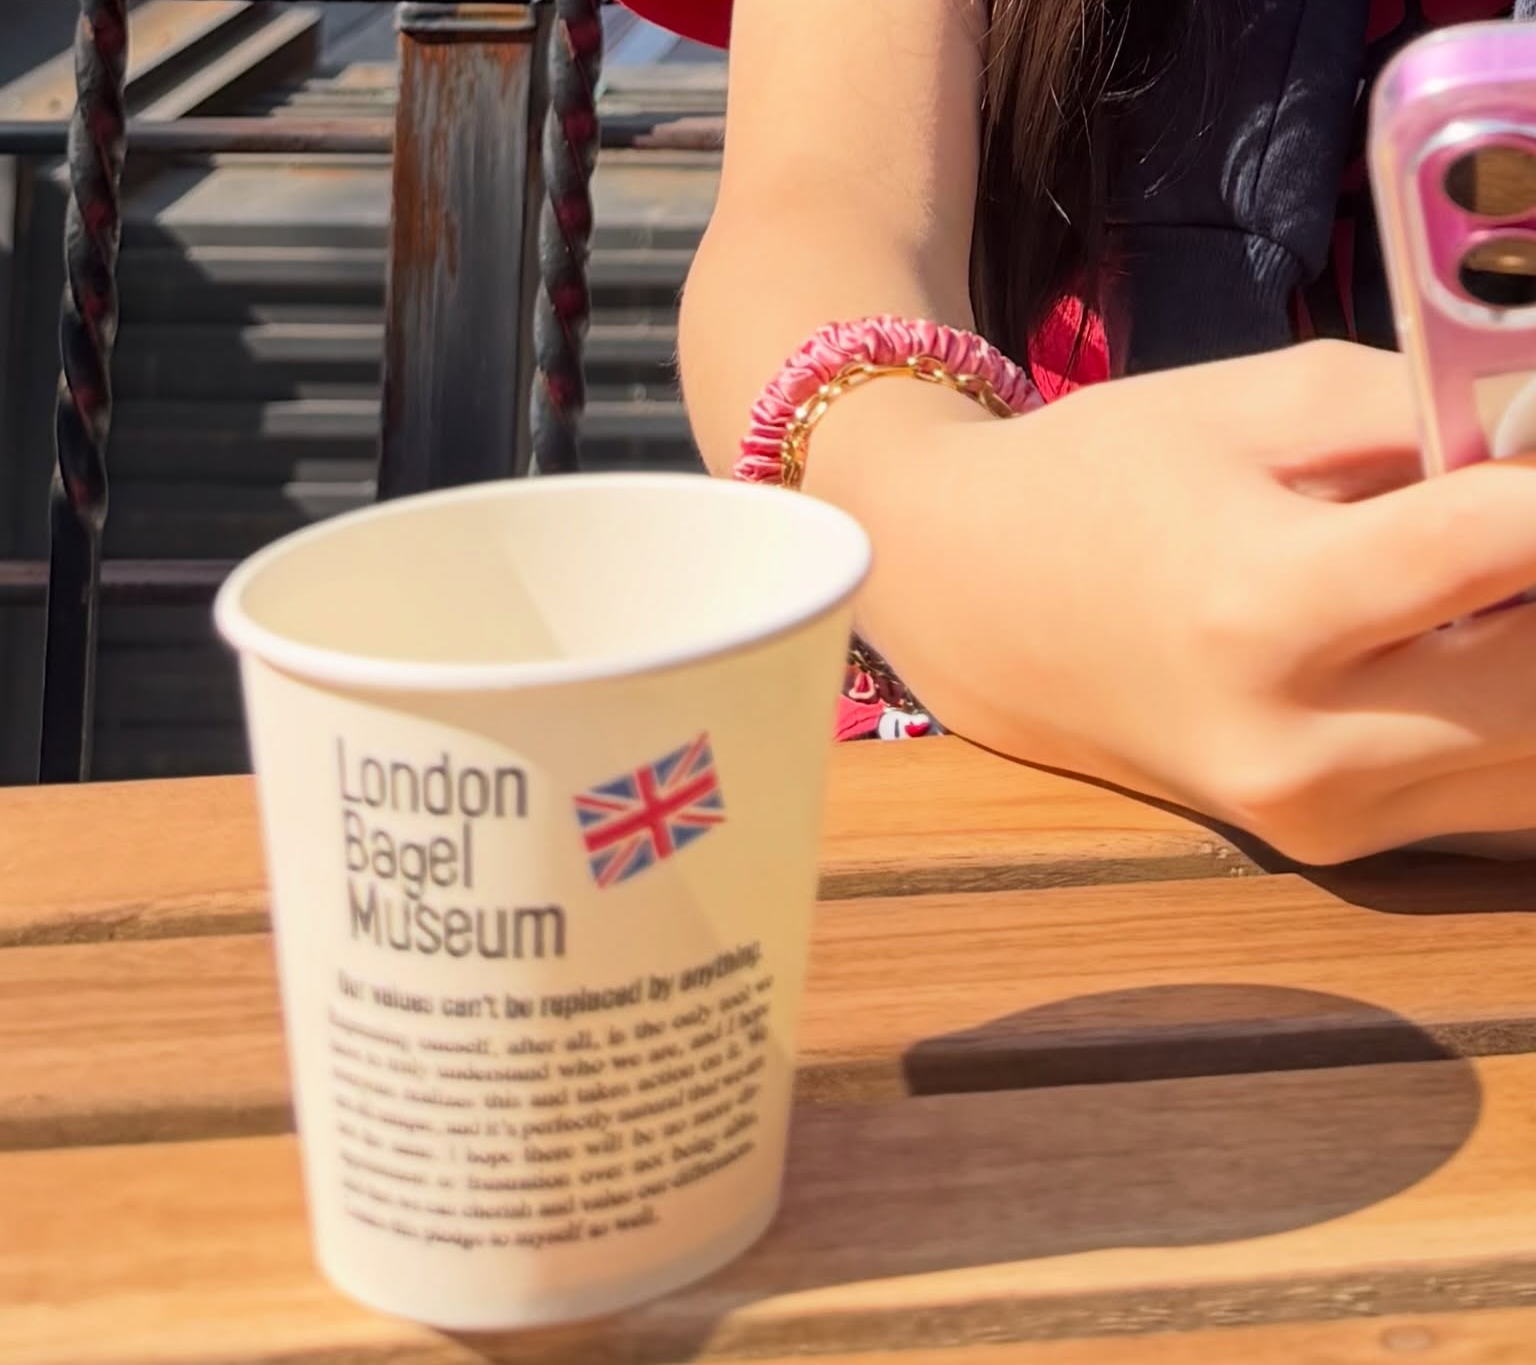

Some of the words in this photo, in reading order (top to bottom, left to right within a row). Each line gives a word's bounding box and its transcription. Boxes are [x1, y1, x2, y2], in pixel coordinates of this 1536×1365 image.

[337, 736, 528, 818] London
[342, 809, 473, 900] Bagel
[347, 879, 566, 959] Museum
[442, 993, 499, 1018] can't
[505, 994, 533, 1018] be
[541, 976, 642, 1020] replaced
[648, 974, 675, 1003] by
[557, 1059, 607, 1077] who
[611, 1054, 642, 1069] we
